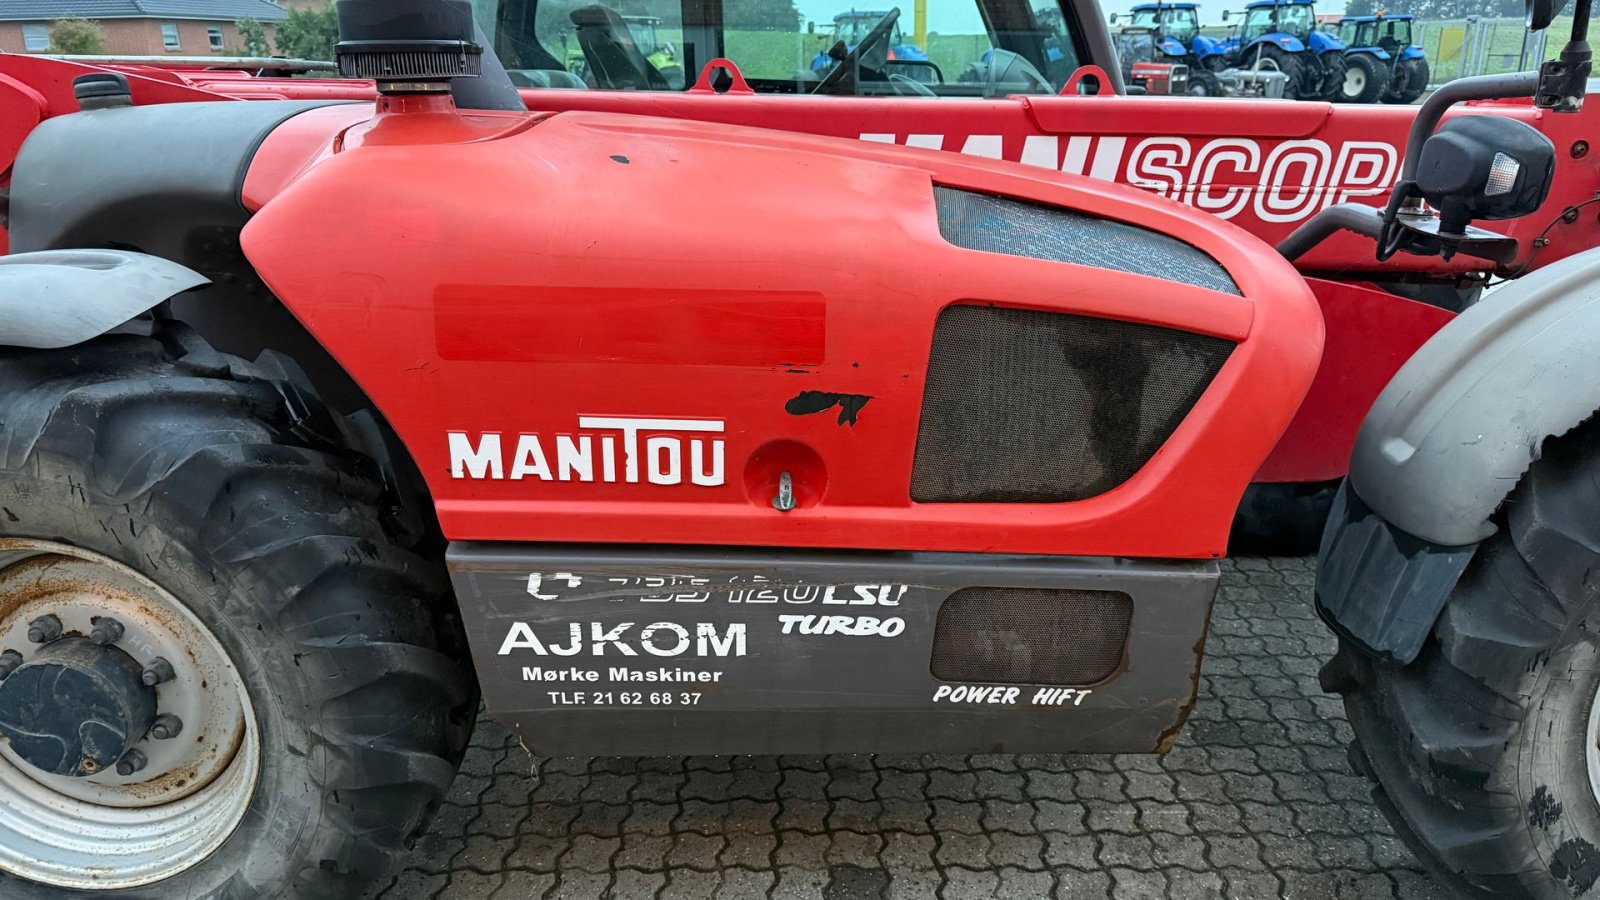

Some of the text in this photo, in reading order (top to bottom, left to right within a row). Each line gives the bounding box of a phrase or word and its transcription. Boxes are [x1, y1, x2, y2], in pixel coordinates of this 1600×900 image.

[448, 416, 725, 486] MANITOU
[778, 614, 906, 638] TURBO
[497, 621, 747, 657] AJKOM
[522, 667, 723, 682] Mørke Maskiner
[547, 692, 702, 705] TLF. 21 62 68 37
[932, 685, 1021, 705] POWER
